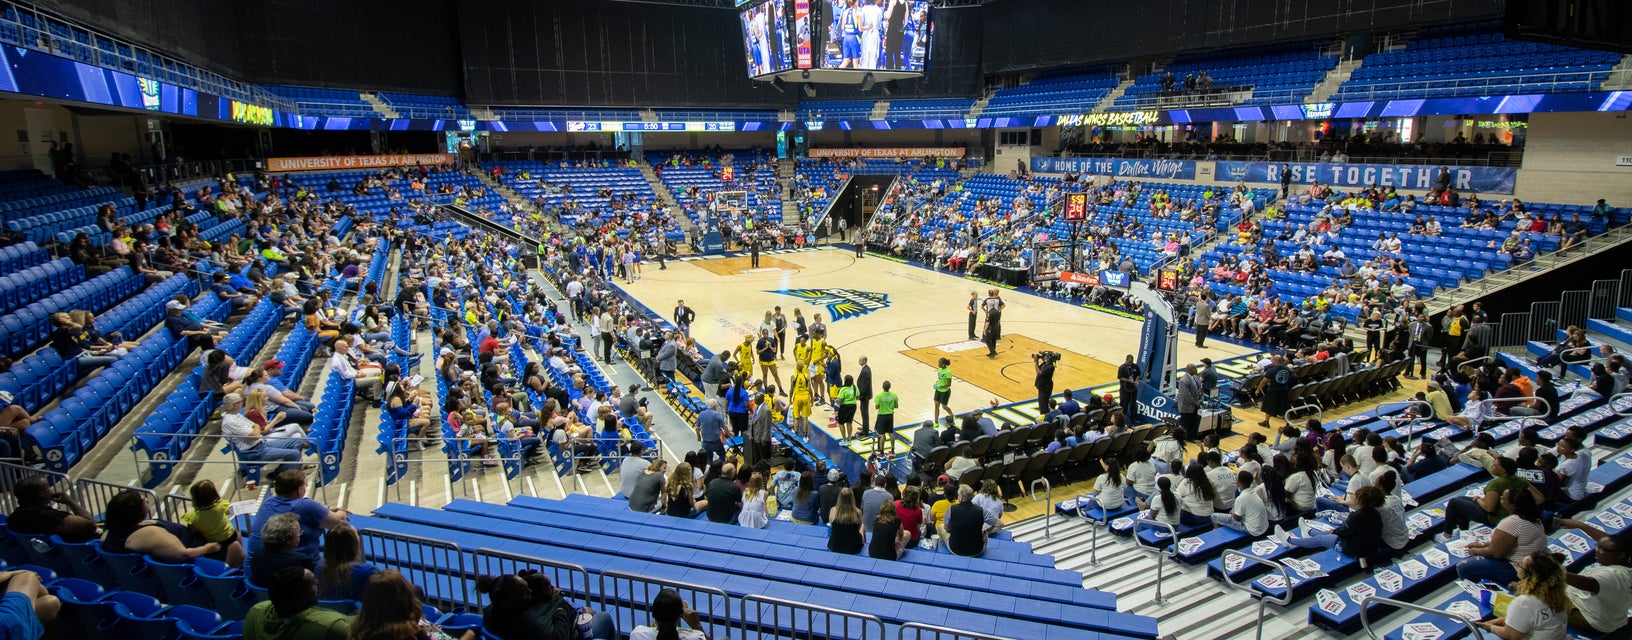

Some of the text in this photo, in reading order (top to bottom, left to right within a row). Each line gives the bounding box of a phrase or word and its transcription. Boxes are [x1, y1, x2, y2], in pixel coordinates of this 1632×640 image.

[1056, 111, 1159, 127] DALLAS WINGS BASKETBALL
[280, 158, 341, 169] UNIVERSITY
[343, 157, 356, 166] OF
[358, 156, 387, 165] TEXAS
[389, 155, 399, 164] AT
[1055, 160, 1183, 180] HOME OF THE Dallas Wings
[1267, 164, 1472, 190] RSE TOGETHR
[1071, 195, 1085, 204] 5:50
[1069, 204, 1083, 218] 24
[1163, 271, 1175, 279] 5:50
[1162, 278, 1174, 289] 24
[1515, 470, 1543, 481] DICK'S
